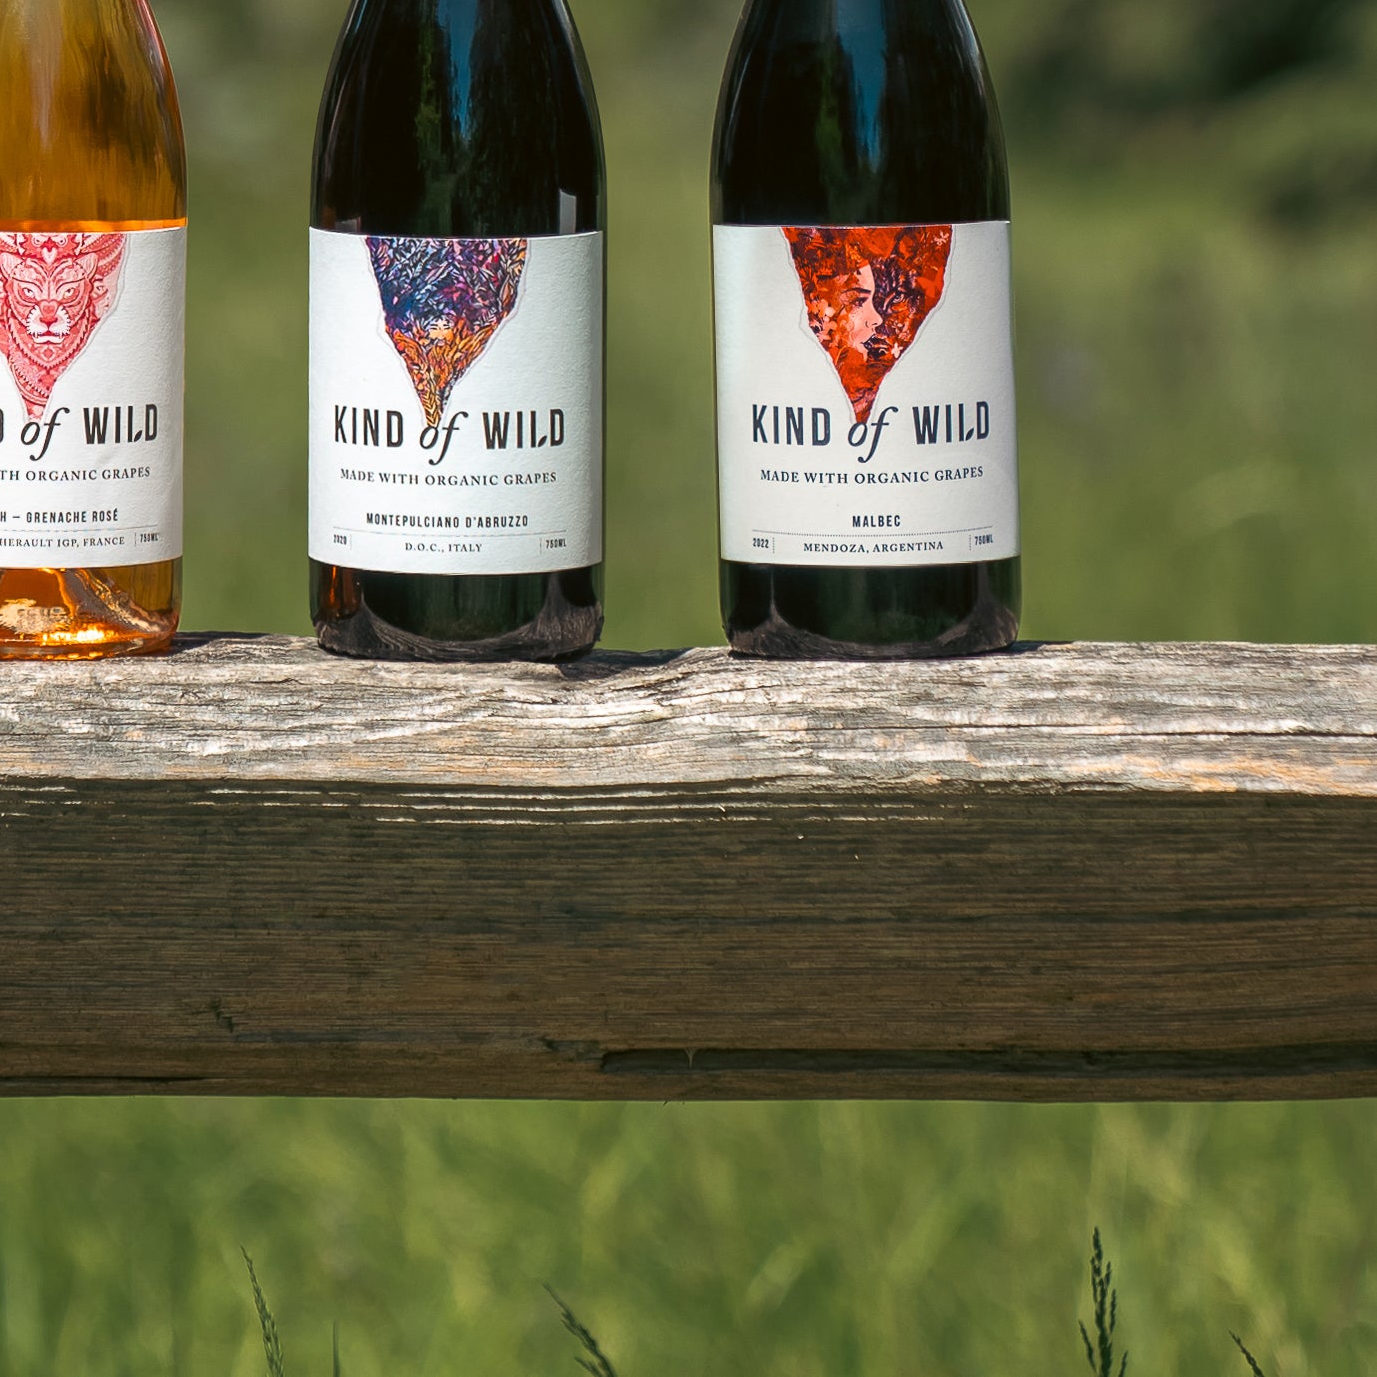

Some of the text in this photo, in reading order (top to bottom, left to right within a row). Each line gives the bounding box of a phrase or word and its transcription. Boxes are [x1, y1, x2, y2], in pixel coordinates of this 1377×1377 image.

[21, 407, 70, 461] of
[83, 404, 158, 445] WILD
[334, 405, 565, 466] KIND of WILD
[752, 400, 990, 463] KIND of WILD
[25, 470, 97, 481] ORGANIC
[102, 466, 150, 480] GRAPES
[340, 468, 557, 486] MADE WITH ORGANIC GRAPES
[760, 466, 983, 484] MADE WITH ORGANIC GRAPES
[26, 511, 86, 523] GRENACHE
[92, 507, 118, 522] ROSÉ
[366, 513, 528, 529] MONTEPULCIANO D'ABRUZZO
[852, 515, 901, 528] MALBEC
[57, 538, 79, 548] IGP,
[84, 536, 125, 547] FRANCE
[448, 544, 482, 553] ITALY
[752, 538, 769, 549] 2022
[804, 541, 944, 554] MENDOZA, ARGENTINA
